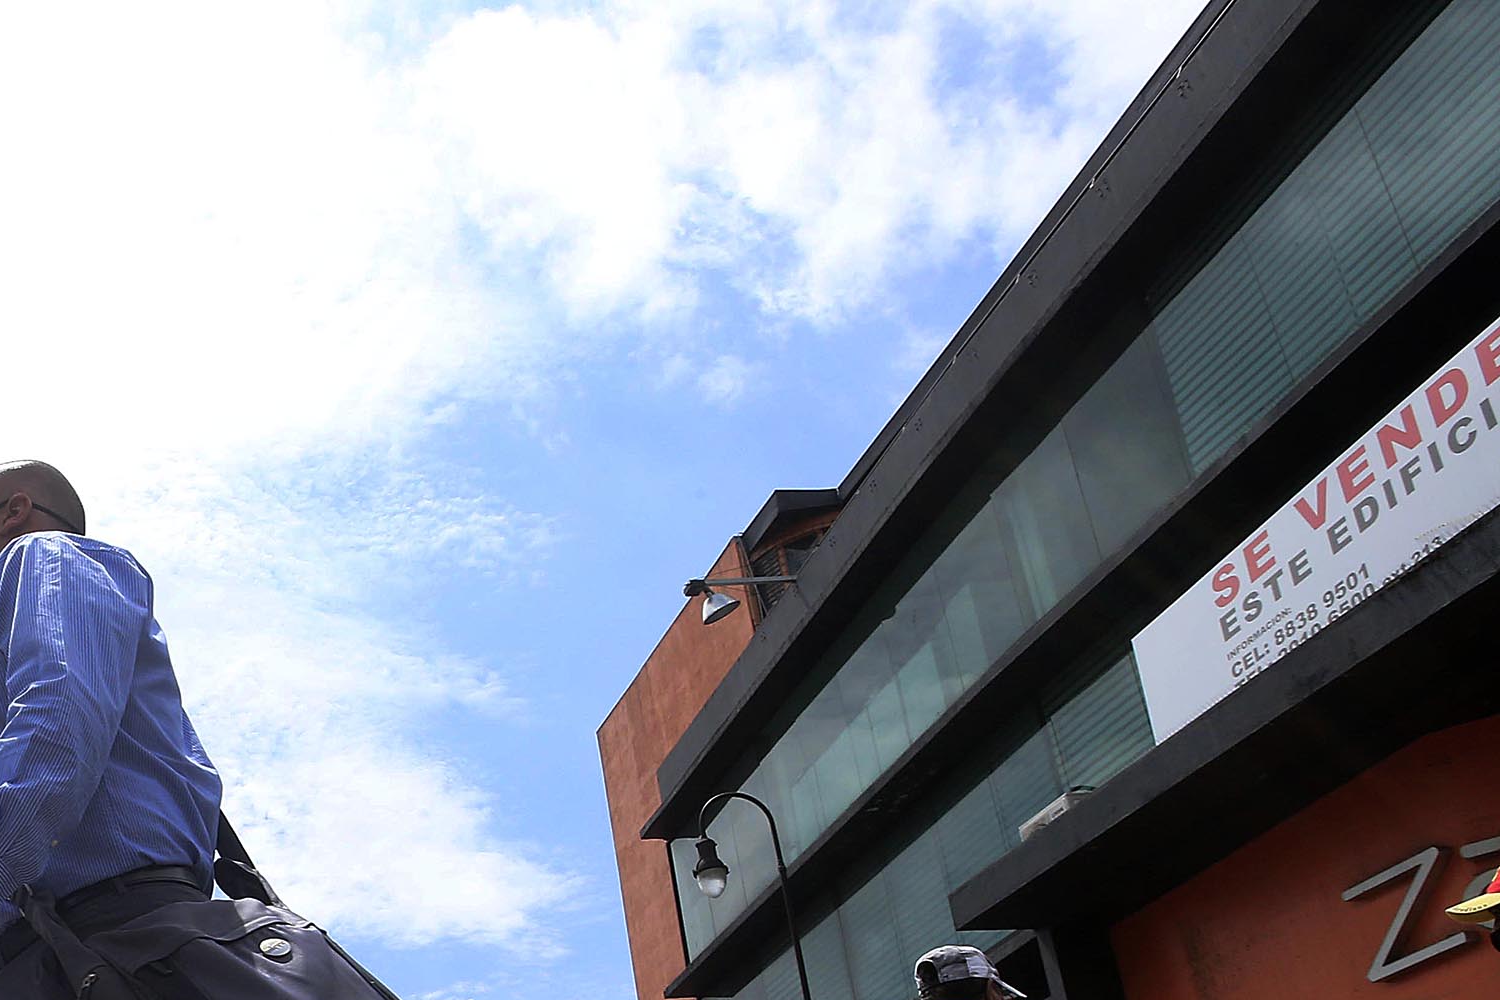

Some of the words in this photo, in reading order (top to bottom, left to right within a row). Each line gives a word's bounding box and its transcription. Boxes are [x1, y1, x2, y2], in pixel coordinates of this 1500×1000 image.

[1212, 530, 1276, 608] SE
[1293, 326, 1500, 531] VENDE
[1219, 549, 1312, 642] ESTE
[1326, 398, 1498, 555] EDIFICI
[1227, 608, 1293, 660] INFORMACION:
[1231, 642, 1271, 678] CEL:
[1274, 603, 1318, 645] 8838
[1323, 563, 1369, 608] 9501
